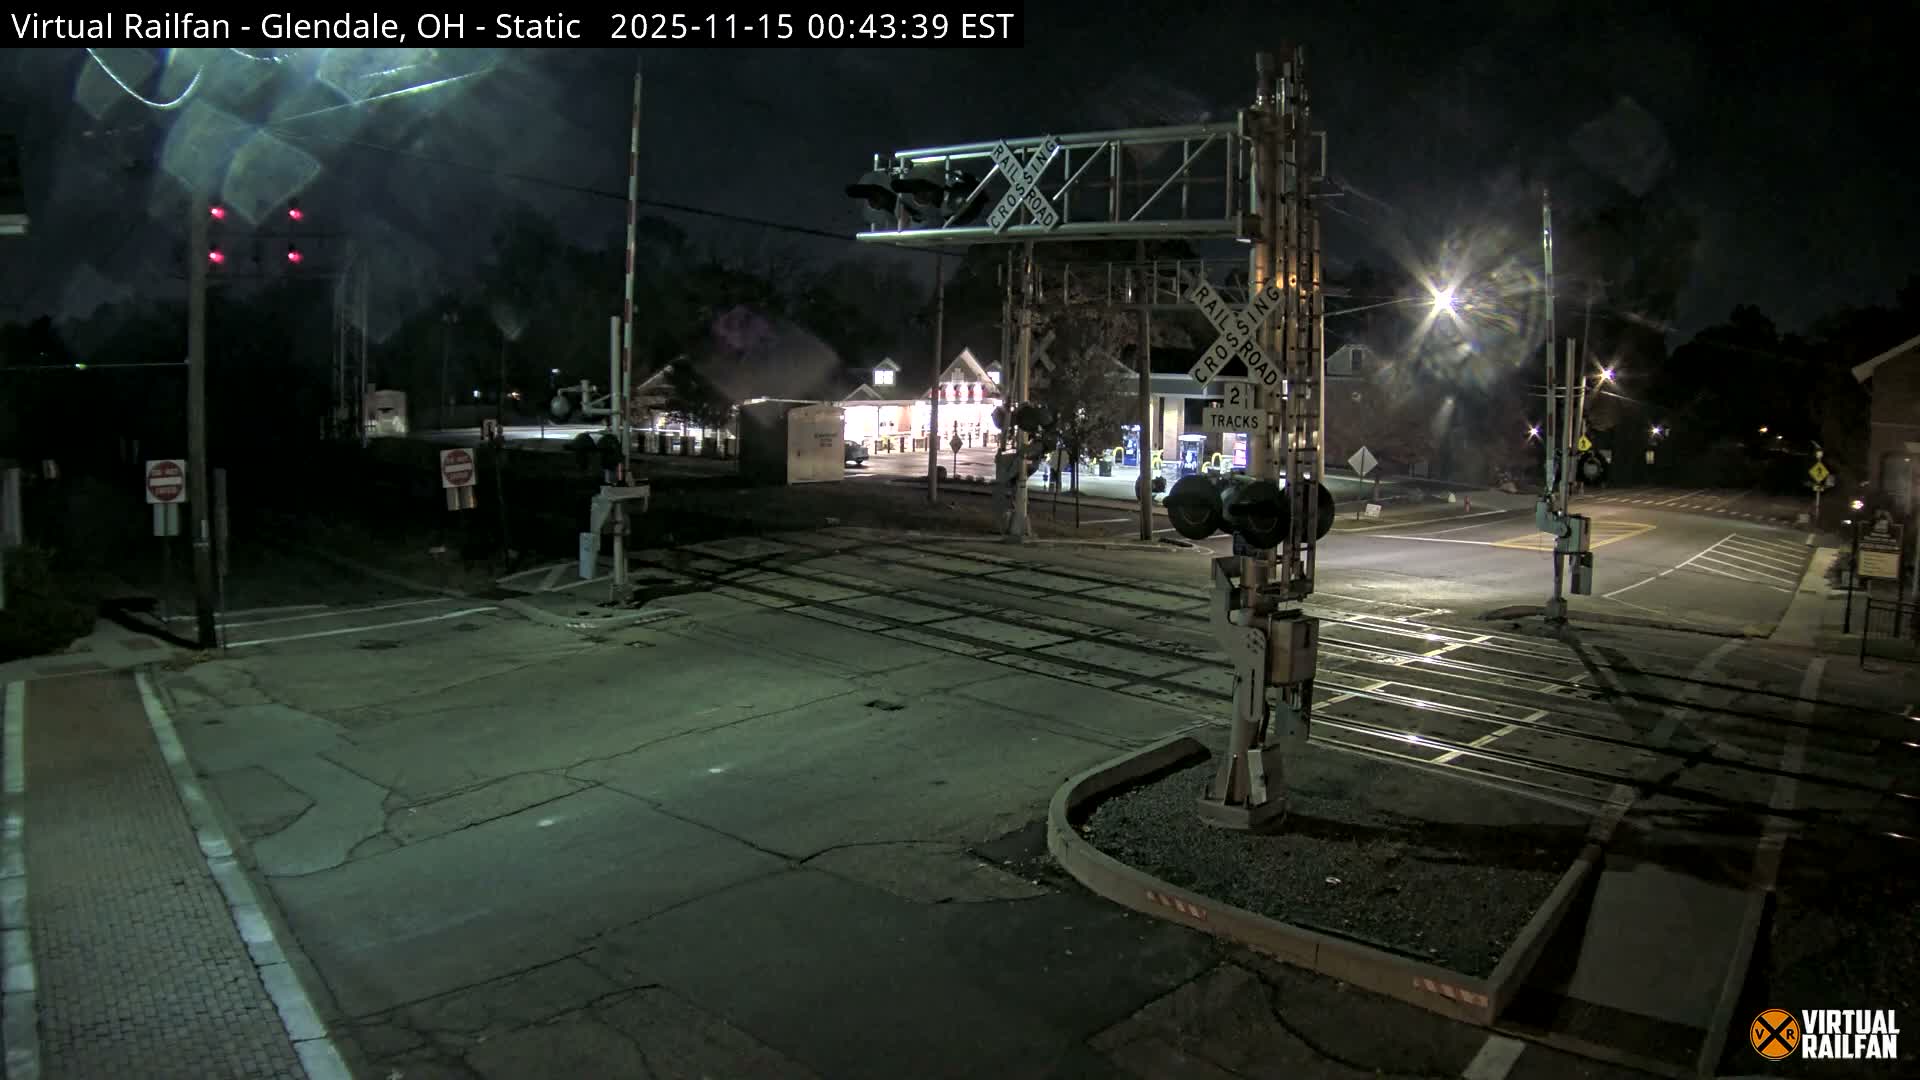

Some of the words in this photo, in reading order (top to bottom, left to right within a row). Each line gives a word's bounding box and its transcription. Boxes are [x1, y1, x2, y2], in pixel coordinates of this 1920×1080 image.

[990, 140, 1056, 228] CROSSING
[1194, 286, 1280, 384] CROSSING
[1210, 414, 1259, 429] TRACKS
[1229, 387, 1241, 405] 2
